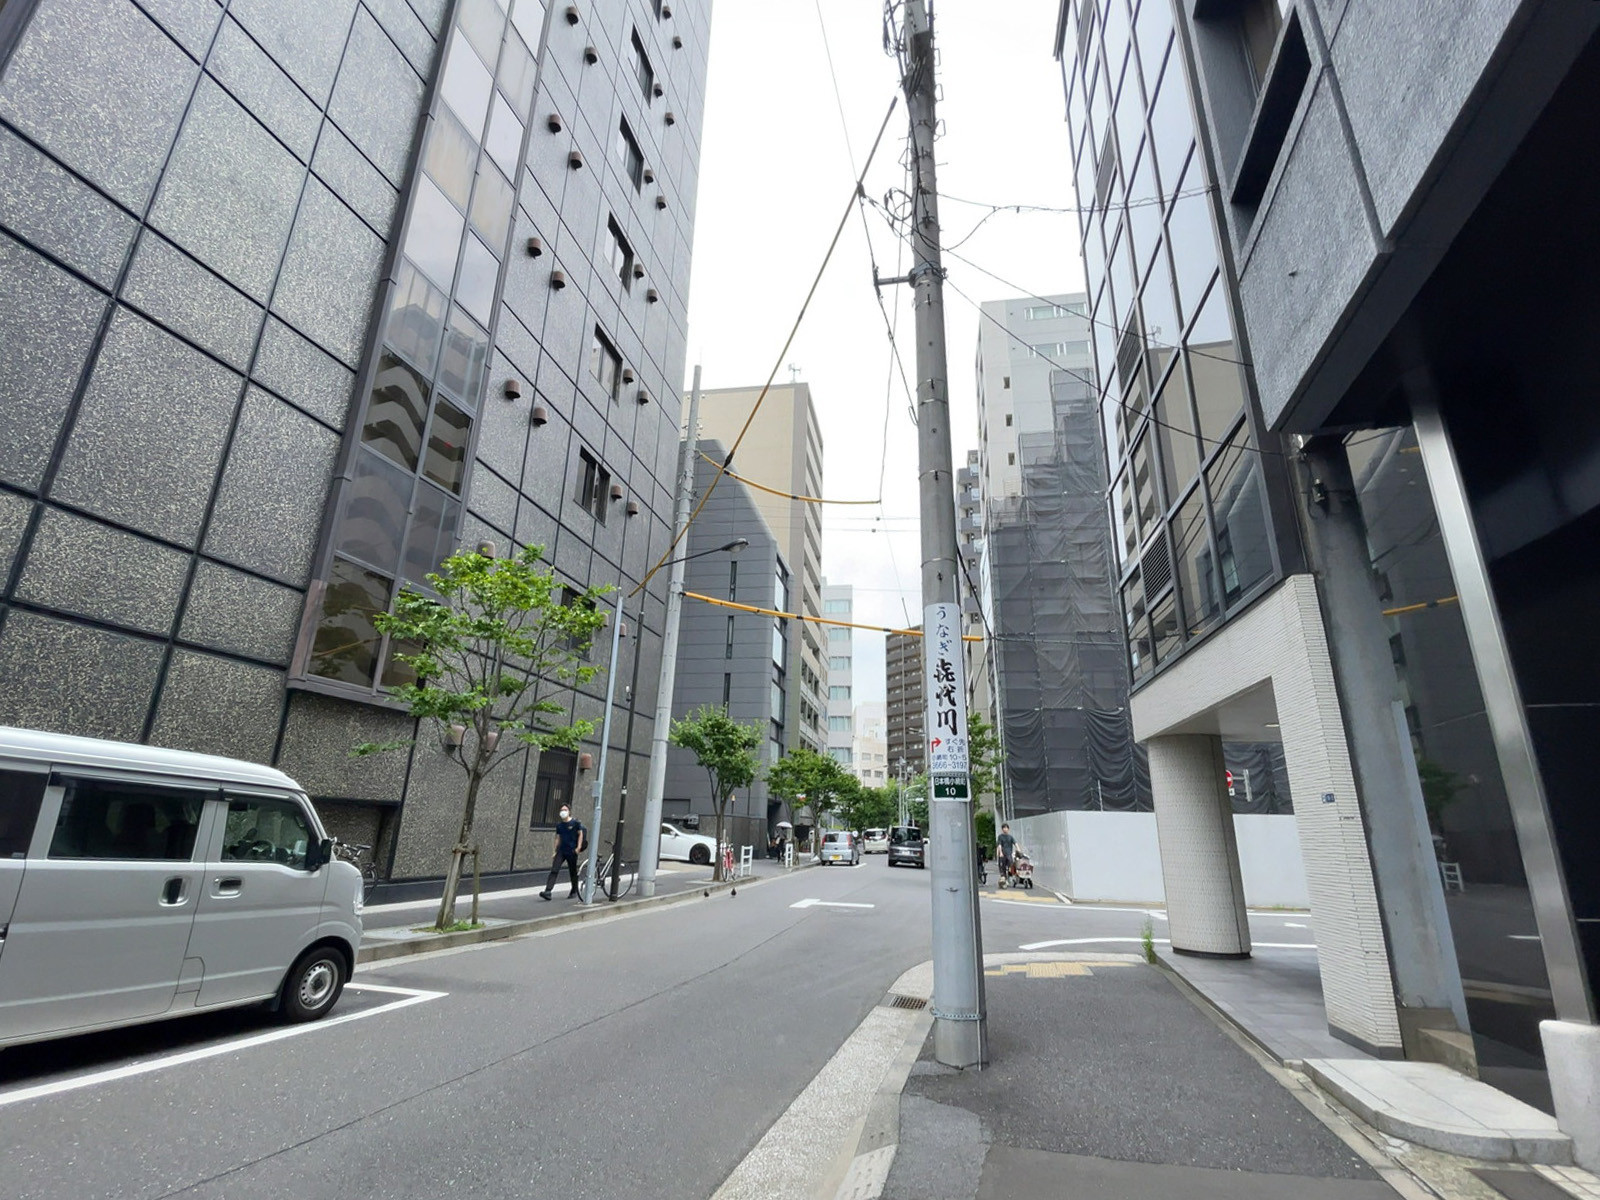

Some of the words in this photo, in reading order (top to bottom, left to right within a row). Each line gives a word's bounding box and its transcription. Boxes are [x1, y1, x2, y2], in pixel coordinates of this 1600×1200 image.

[936, 606, 952, 655] うなぎ
[945, 787, 957, 796] 10
